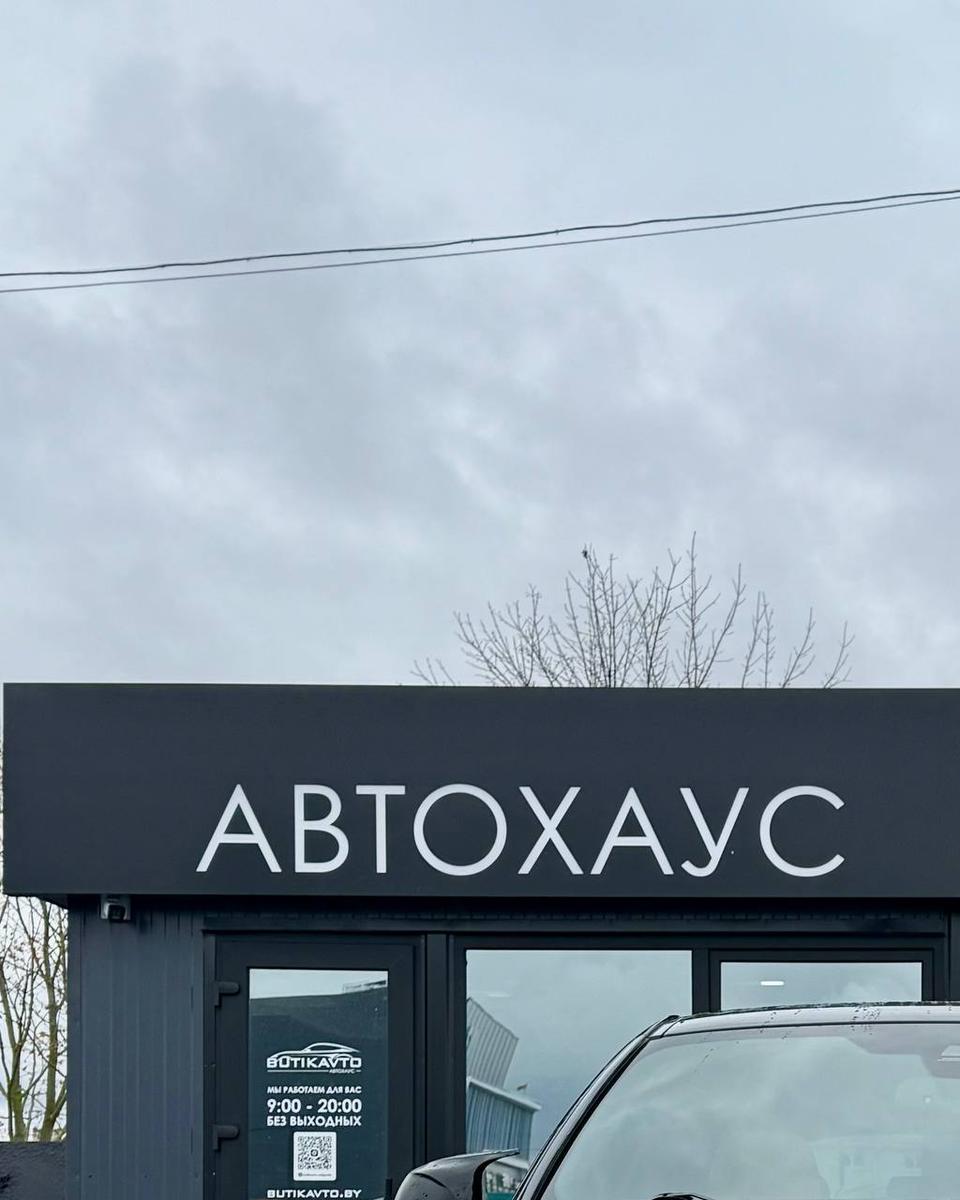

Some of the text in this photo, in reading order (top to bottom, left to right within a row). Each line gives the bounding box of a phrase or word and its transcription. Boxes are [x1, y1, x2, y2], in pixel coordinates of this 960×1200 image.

[196, 783, 845, 878] АВТОХАУС
[266, 1057, 362, 1069] BUTIKAVTO
[267, 1086, 362, 1095] МЫ РАБОТАЕМ ДЛЯ ВАС
[267, 1099, 302, 1113] 9:00
[317, 1099, 362, 1113] 20:00
[266, 1115, 362, 1127] БЕЗ ВЫХОДНЫХ
[267, 1189, 362, 1198] BUTIKAVTO.BY
